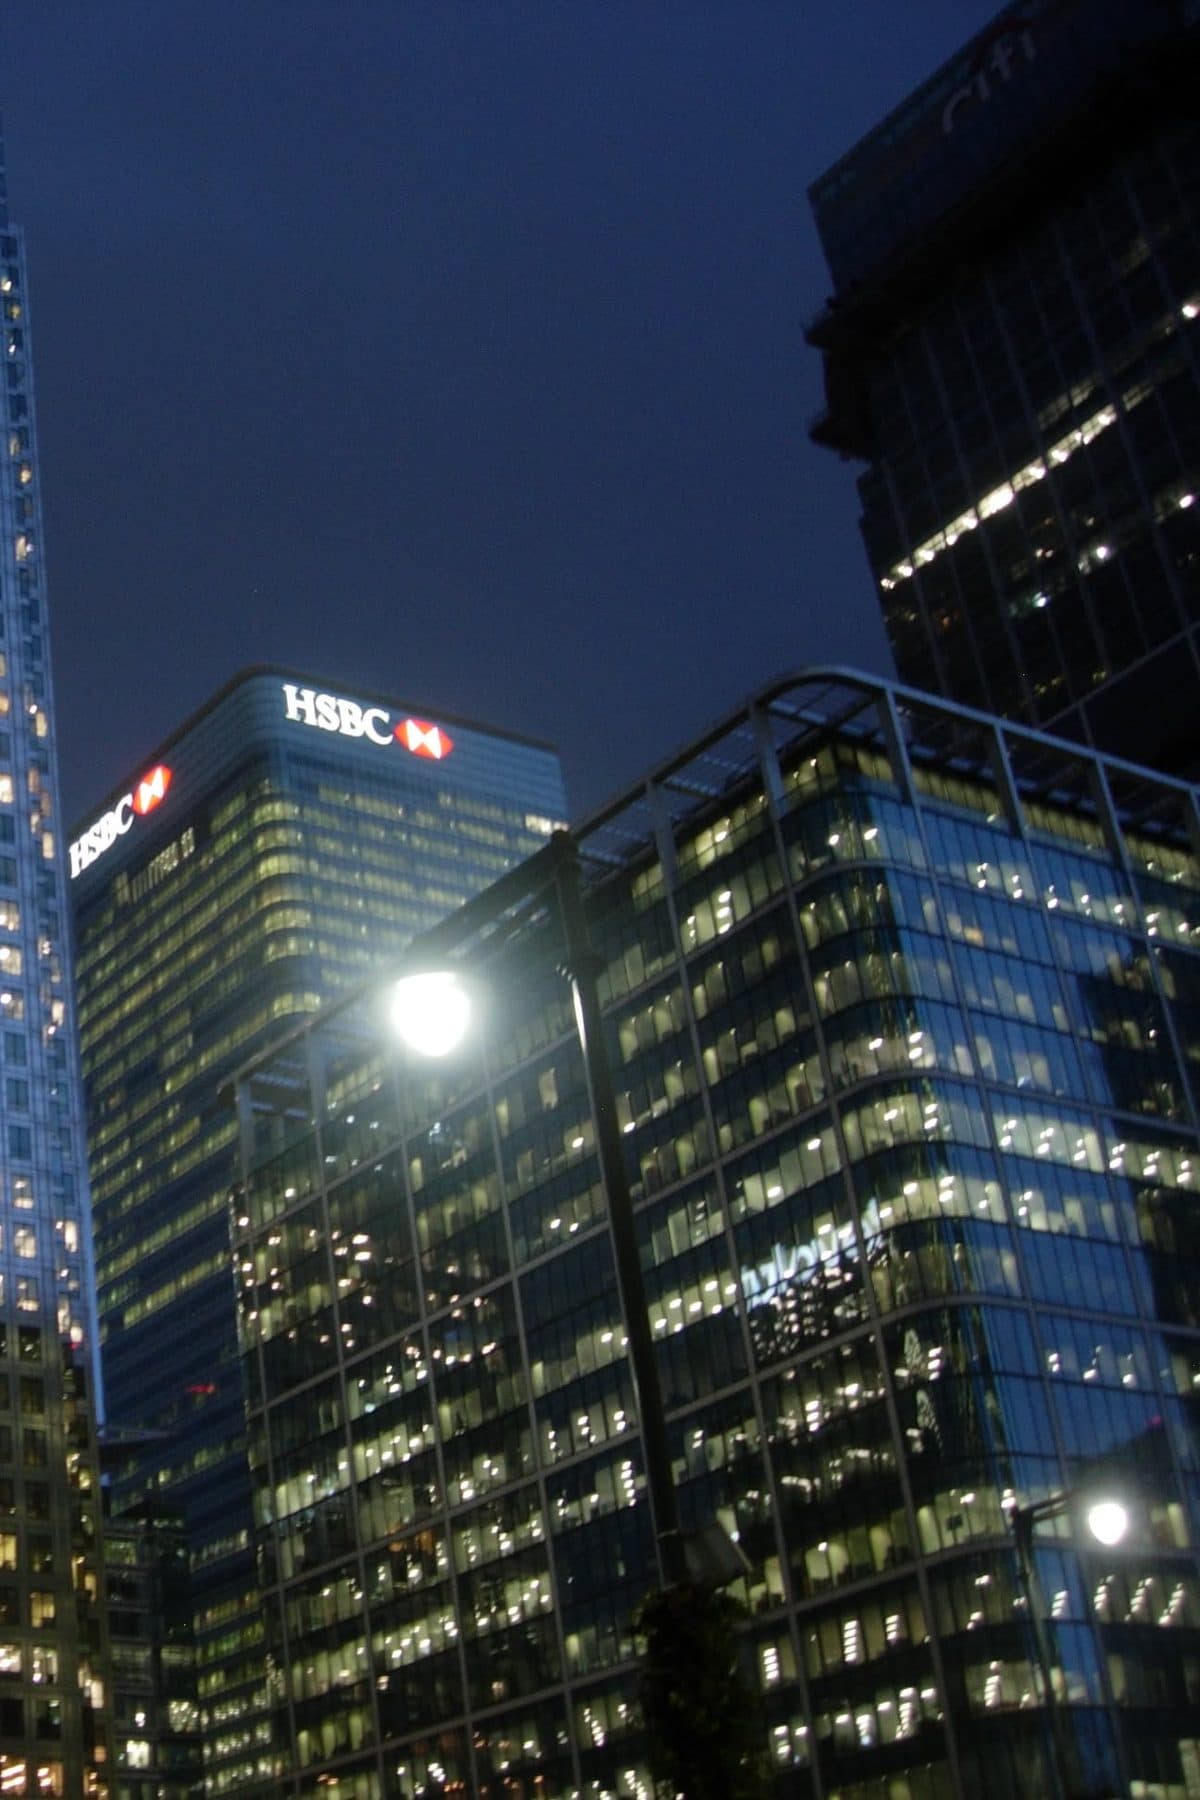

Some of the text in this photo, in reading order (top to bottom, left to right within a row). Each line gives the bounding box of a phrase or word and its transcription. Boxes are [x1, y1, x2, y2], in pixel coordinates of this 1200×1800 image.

[941, 28, 1037, 134] citi
[282, 684, 394, 745] HSBC
[68, 793, 134, 879] HSBC
